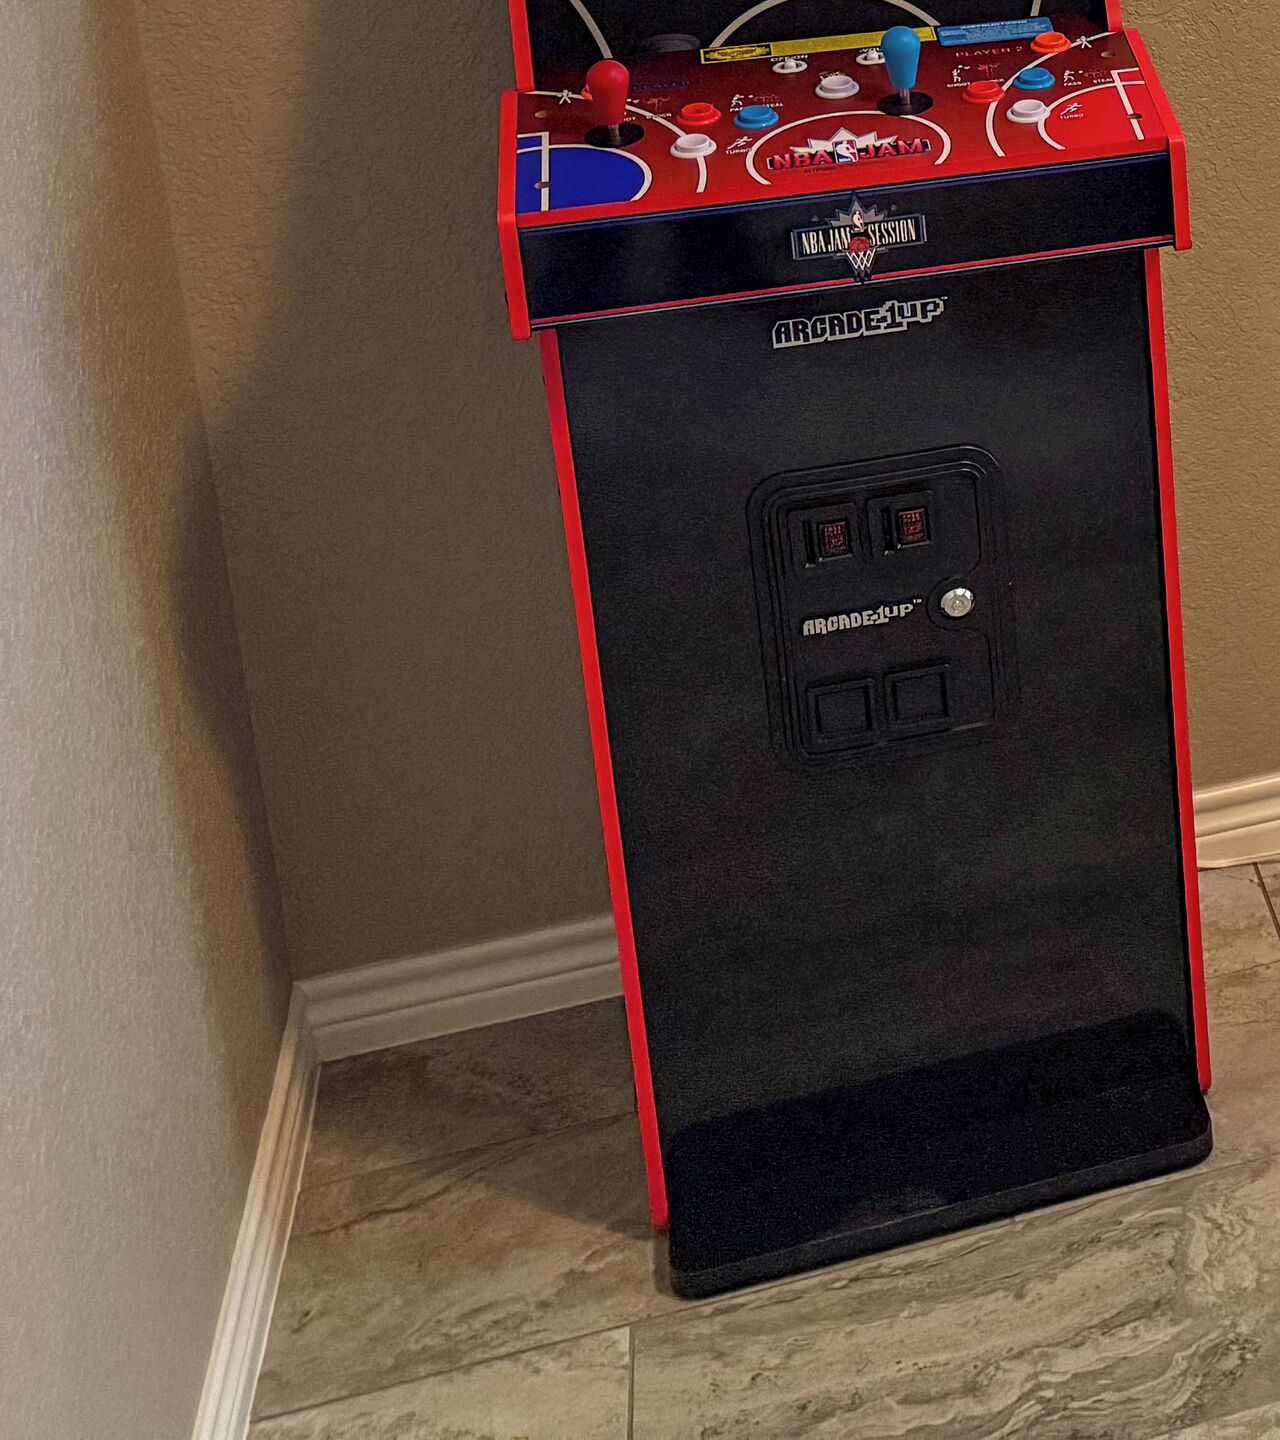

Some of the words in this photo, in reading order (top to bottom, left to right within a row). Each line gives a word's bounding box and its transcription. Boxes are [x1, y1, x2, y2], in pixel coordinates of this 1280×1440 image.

[771, 148, 833, 171] NBA
[859, 137, 925, 159] JAM
[801, 227, 827, 255] NBA
[868, 217, 917, 246] SESSION
